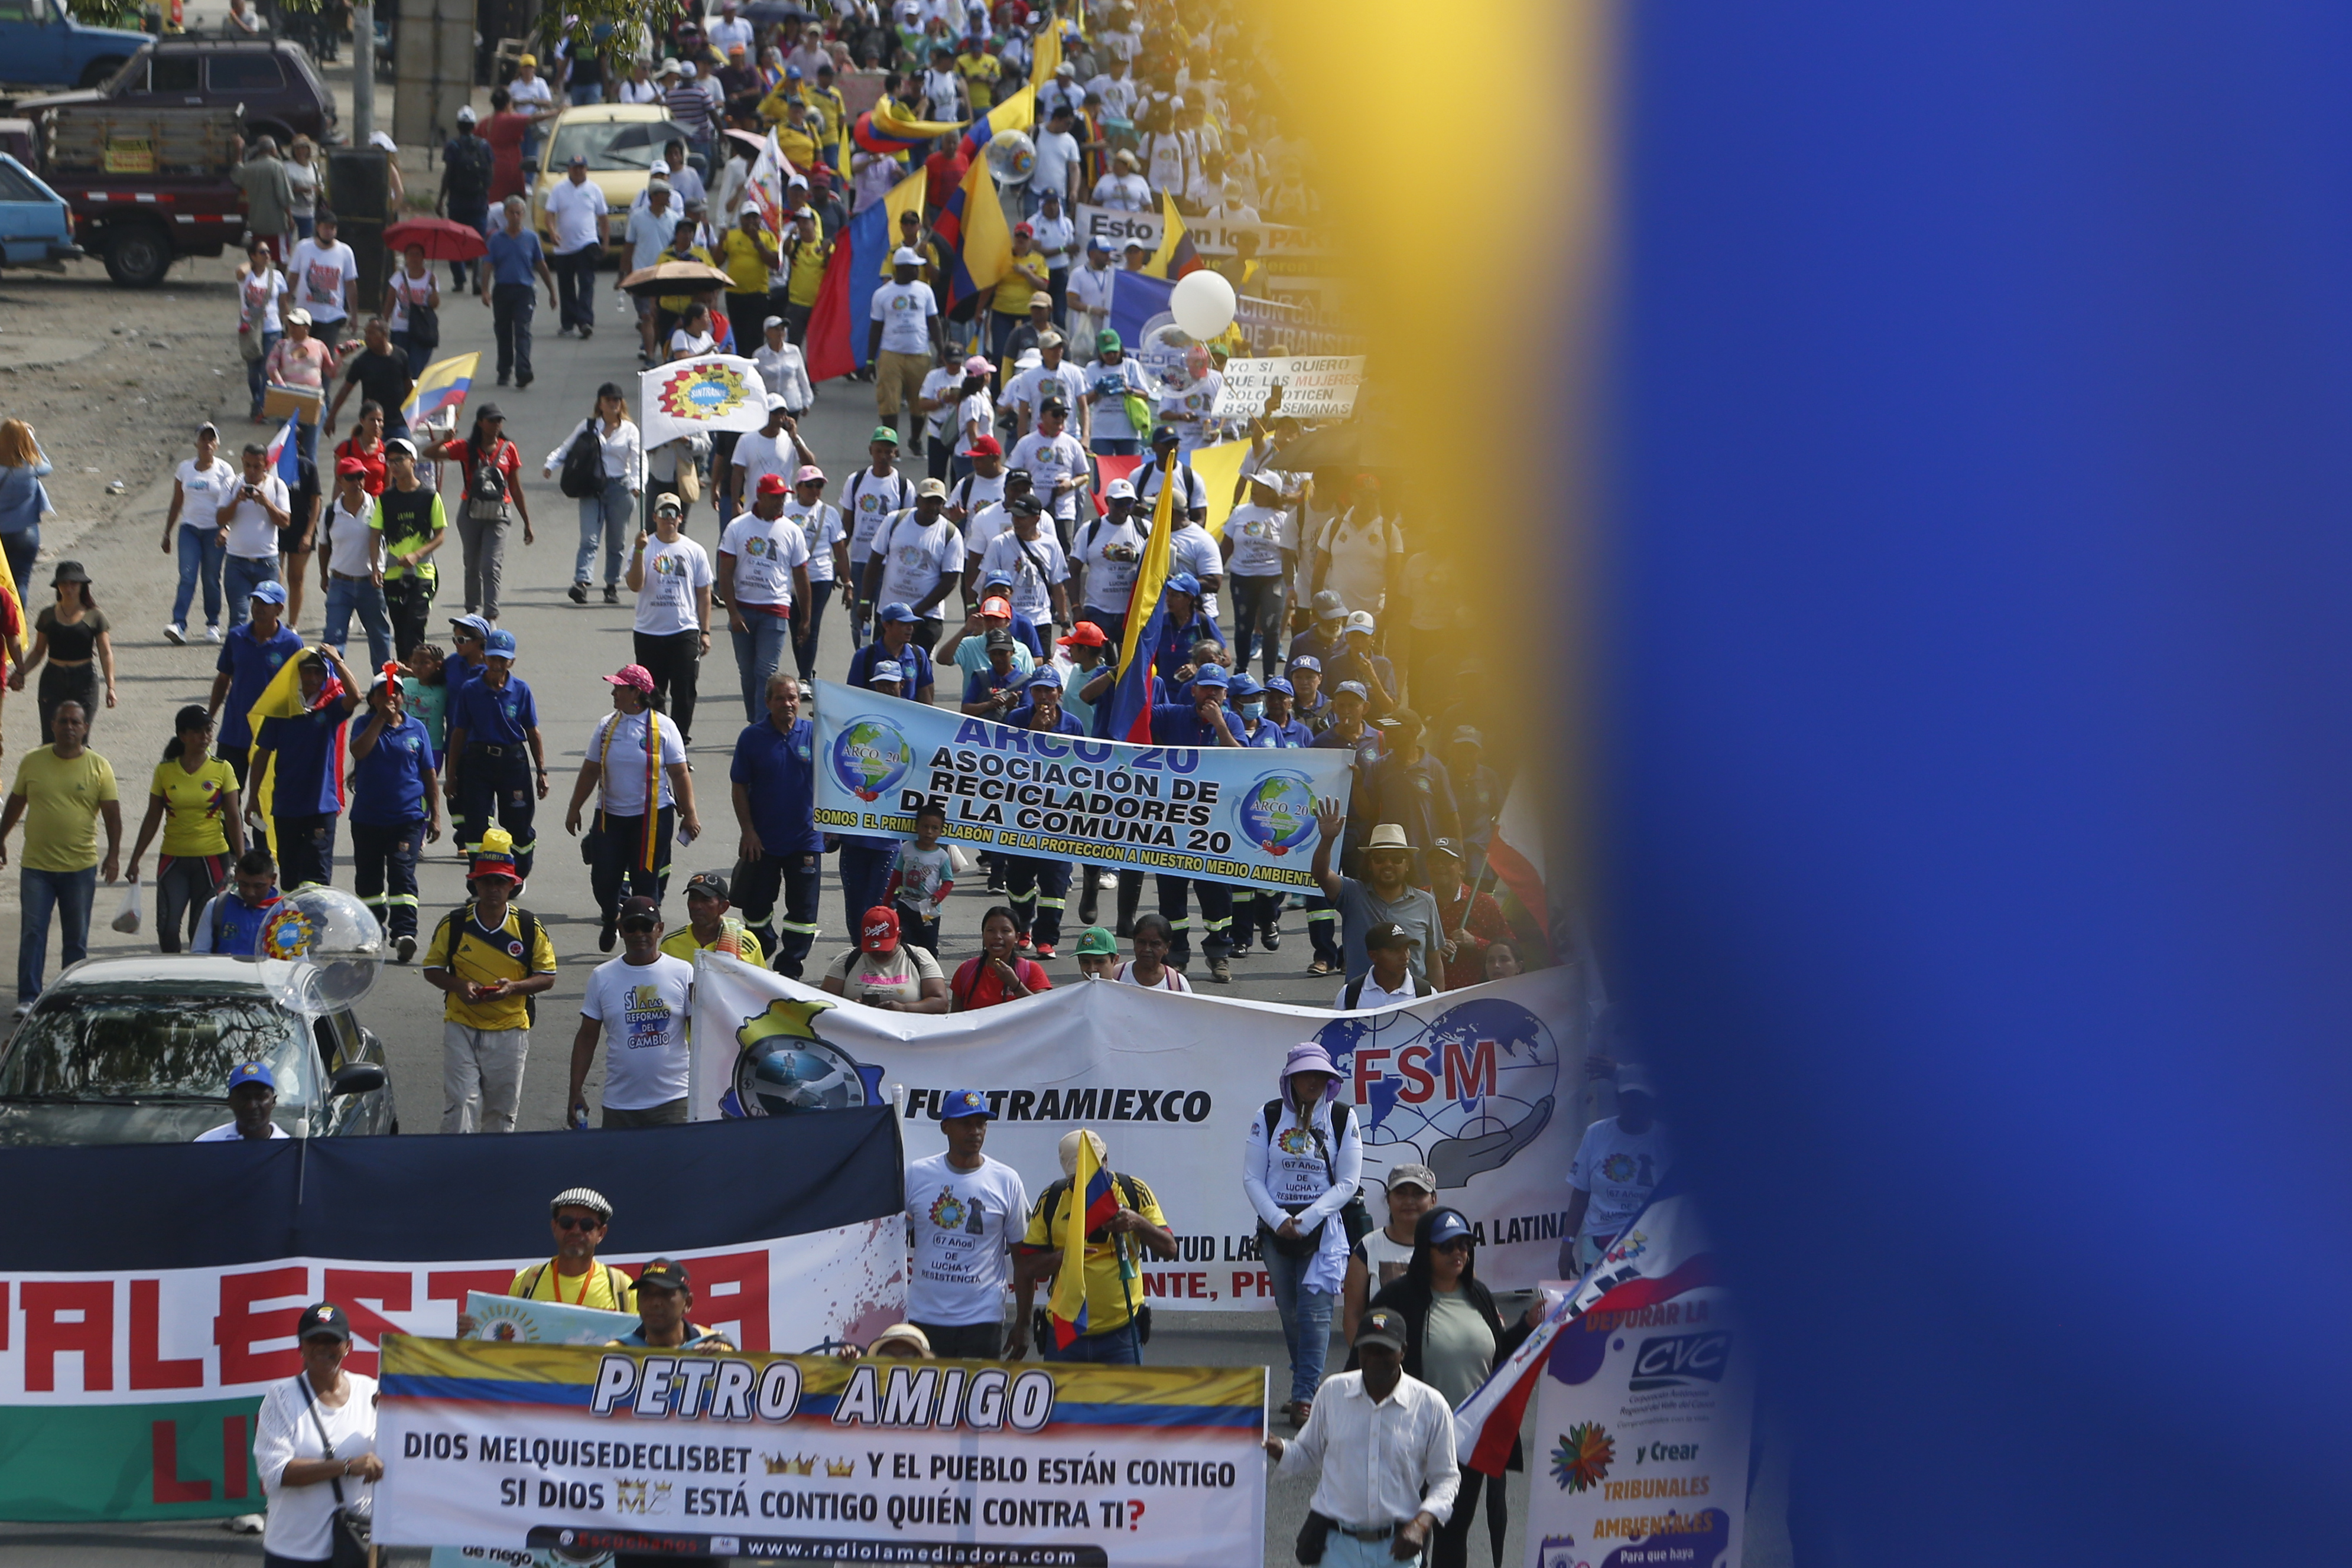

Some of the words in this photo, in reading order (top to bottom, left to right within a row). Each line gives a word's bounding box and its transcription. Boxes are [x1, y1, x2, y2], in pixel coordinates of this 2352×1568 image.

[1089, 213, 1154, 240] Esto
[1229, 362, 1249, 372] YO
[1259, 362, 1274, 372] SI
[1291, 358, 1350, 372] QUIERO
[1223, 375, 1255, 387] QUE
[1262, 375, 1290, 387] LAS
[1294, 373, 1360, 387] MUJERES
[1226, 390, 1266, 401] SOLO
[1281, 388, 1334, 401] OTICEN
[1223, 402, 1258, 414] 850
[1281, 402, 1350, 414] SEMANAS
[841, 745, 879, 760] ARCO
[885, 752, 900, 763] 20
[954, 717, 1114, 764] ARCO
[1130, 747, 1200, 773] 20
[928, 747, 1159, 798] ASOCIACIÓN
[1171, 778, 1221, 805] DE
[928, 770, 1211, 827] RECICLADORES
[1250, 801, 1288, 814] ARCO
[1294, 805, 1309, 816] 20
[959, 799, 1004, 825] LA
[1015, 808, 1177, 848] COMUNA
[1186, 828, 1233, 855] 20
[813, 807, 858, 828] SOMOS
[862, 814, 878, 830] EL
[940, 822, 993, 844] SLABÓN
[998, 831, 1018, 846] DE
[1019, 834, 1038, 849] LA
[1039, 837, 1125, 861] PROTECCIÓN
[1126, 851, 1138, 864] A
[1139, 850, 1204, 873] NUESTRO
[1205, 858, 1250, 879] MEDIO
[1250, 864, 1321, 889] AMBIENTE
[865, 920, 889, 936] Dodgers
[624, 985, 638, 1011] SÍ
[639, 1000, 647, 1009] A
[648, 998, 664, 1009] LAS
[625, 1009, 670, 1024] REFORMAS
[641, 1023, 655, 1033] DEL
[628, 1033, 670, 1049] CAMBIO
[1354, 1040, 1497, 1105] FSM
[1299, 1161, 1321, 1172] Años
[1286, 1183, 1312, 1192] LUCHA
[1609, 1190, 1620, 1198] 67
[935, 1236, 947, 1245] 67
[948, 1237, 973, 1248] Años
[945, 1251, 958, 1261] DE
[931, 1261, 962, 1272] LUCHA
[921, 1269, 981, 1284] RESISTENCIA
[1585, 1303, 1681, 1333] DEPURAR
[1685, 1301, 1710, 1323] LA
[1638, 1334, 1726, 1375] CVC
[590, 1354, 802, 1424] PETRO
[831, 1364, 1055, 1434] AMIGO
[404, 1432, 469, 1460] DIOS
[479, 1435, 752, 1475] MELQUISEDECLISBET
[867, 1452, 886, 1476] Y
[893, 1453, 921, 1478] EL
[930, 1455, 1028, 1484] PUEBLO
[1038, 1450, 1116, 1485] ESTÁN
[1126, 1460, 1236, 1488] CONTIGO
[1636, 1446, 1646, 1465] y
[1651, 1441, 1700, 1462] Crear
[1603, 1476, 1711, 1502] TRIBUNALES
[500, 1478, 525, 1507] SI
[538, 1481, 605, 1510] DIOS
[684, 1480, 750, 1517] ESTÁ
[760, 1490, 878, 1523] CONTIGO
[887, 1487, 972, 1530] QUIÉN
[982, 1498, 1090, 1530] CONTRA
[1099, 1499, 1146, 1531] TI?
[1593, 1511, 1714, 1540] AMBIENTALES
[488, 1546, 532, 1567] riego
[577, 1532, 699, 1553] Escúchanos
[747, 1540, 1076, 1566] www.radiolamediadora.com
[1620, 1549, 1644, 1564] Para
[1646, 1550, 1667, 1564] que
[1669, 1547, 1695, 1561] haya
